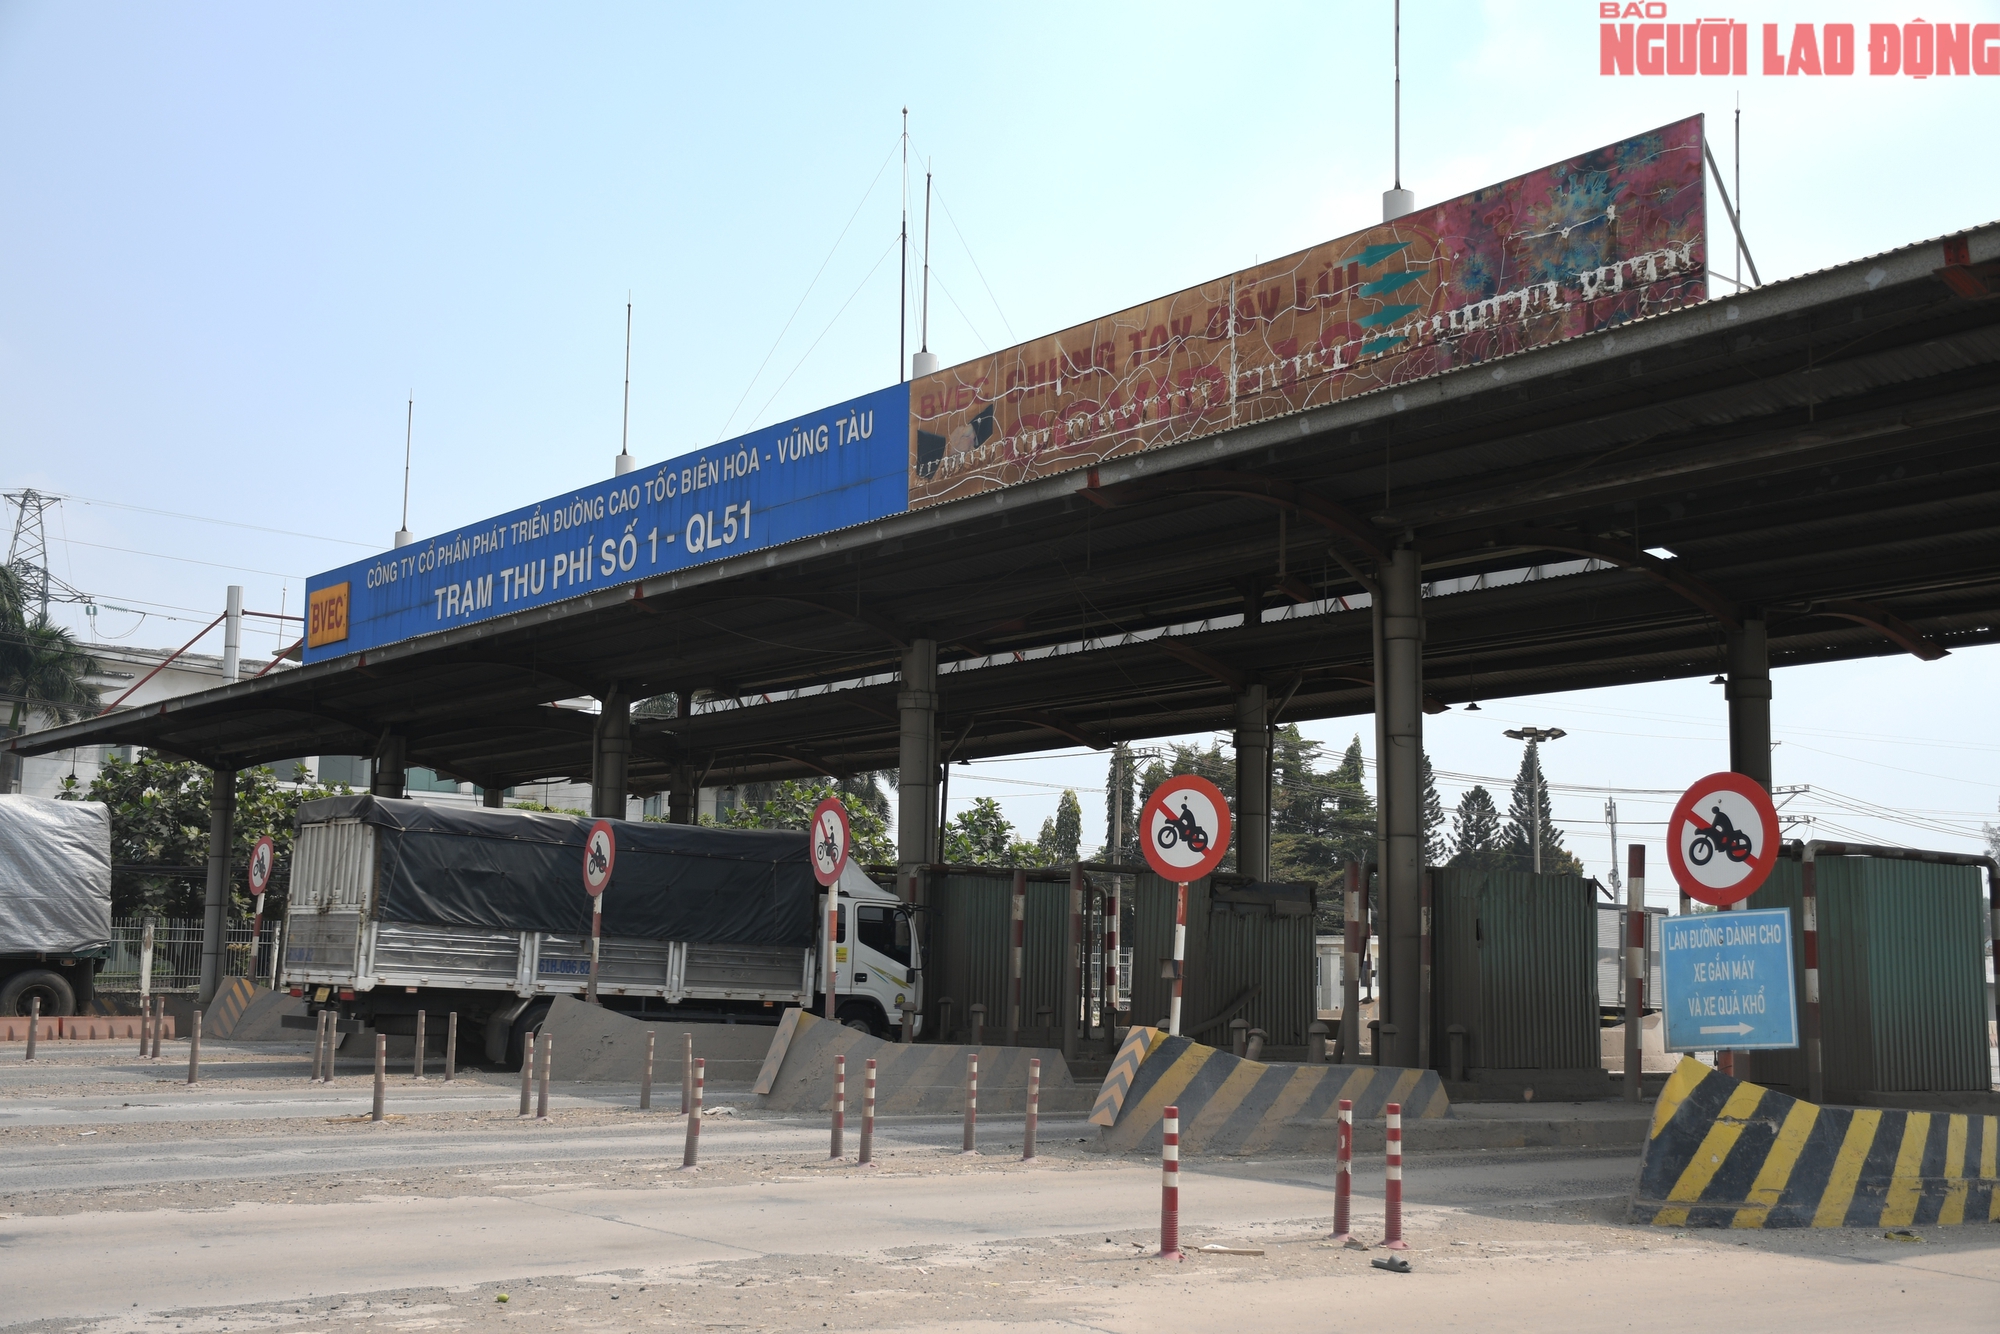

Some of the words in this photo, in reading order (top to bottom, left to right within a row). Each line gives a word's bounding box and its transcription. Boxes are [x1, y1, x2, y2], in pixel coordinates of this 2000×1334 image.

[1006, 340, 1116, 404] CHUNG
[1128, 315, 1193, 367] TAY
[1296, 261, 1359, 317] LÙI
[920, 377, 990, 419] BVEC
[367, 561, 398, 589] CÔNG
[401, 555, 416, 578] TY
[418, 539, 435, 574] CỔ
[438, 534, 470, 568] PHẦN
[473, 524, 507, 557] PHÁT
[511, 505, 550, 545] TRIỂN
[554, 496, 604, 533] ĐƯỜNG
[608, 485, 640, 515] CAO
[645, 466, 677, 505] TỐC
[681, 457, 720, 494] BIÊN
[723, 443, 760, 482] HÒA
[777, 427, 829, 464] VŨNG
[835, 409, 874, 446] TÀU
[434, 573, 493, 620] TRẠM
[500, 558, 546, 603] THU
[553, 535, 595, 590] PHÍ
[600, 517, 639, 577] SỐ
[648, 526, 658, 564] 1
[685, 500, 751, 554] QL51
[311, 596, 344, 635] BVEC
[1668, 925, 1688, 951] LÀN
[1689, 922, 1724, 949] ĐƯỜNG
[1726, 921, 1757, 946] DÀNH
[1759, 924, 1781, 944] CHO
[1693, 962, 1707, 983] XE
[1708, 952, 1730, 981] GẮN
[1732, 954, 1755, 980] MÁY
[1688, 991, 1702, 1017] VÀ
[1703, 996, 1716, 1016] XE
[1742, 985, 1765, 1015] KHỔ
